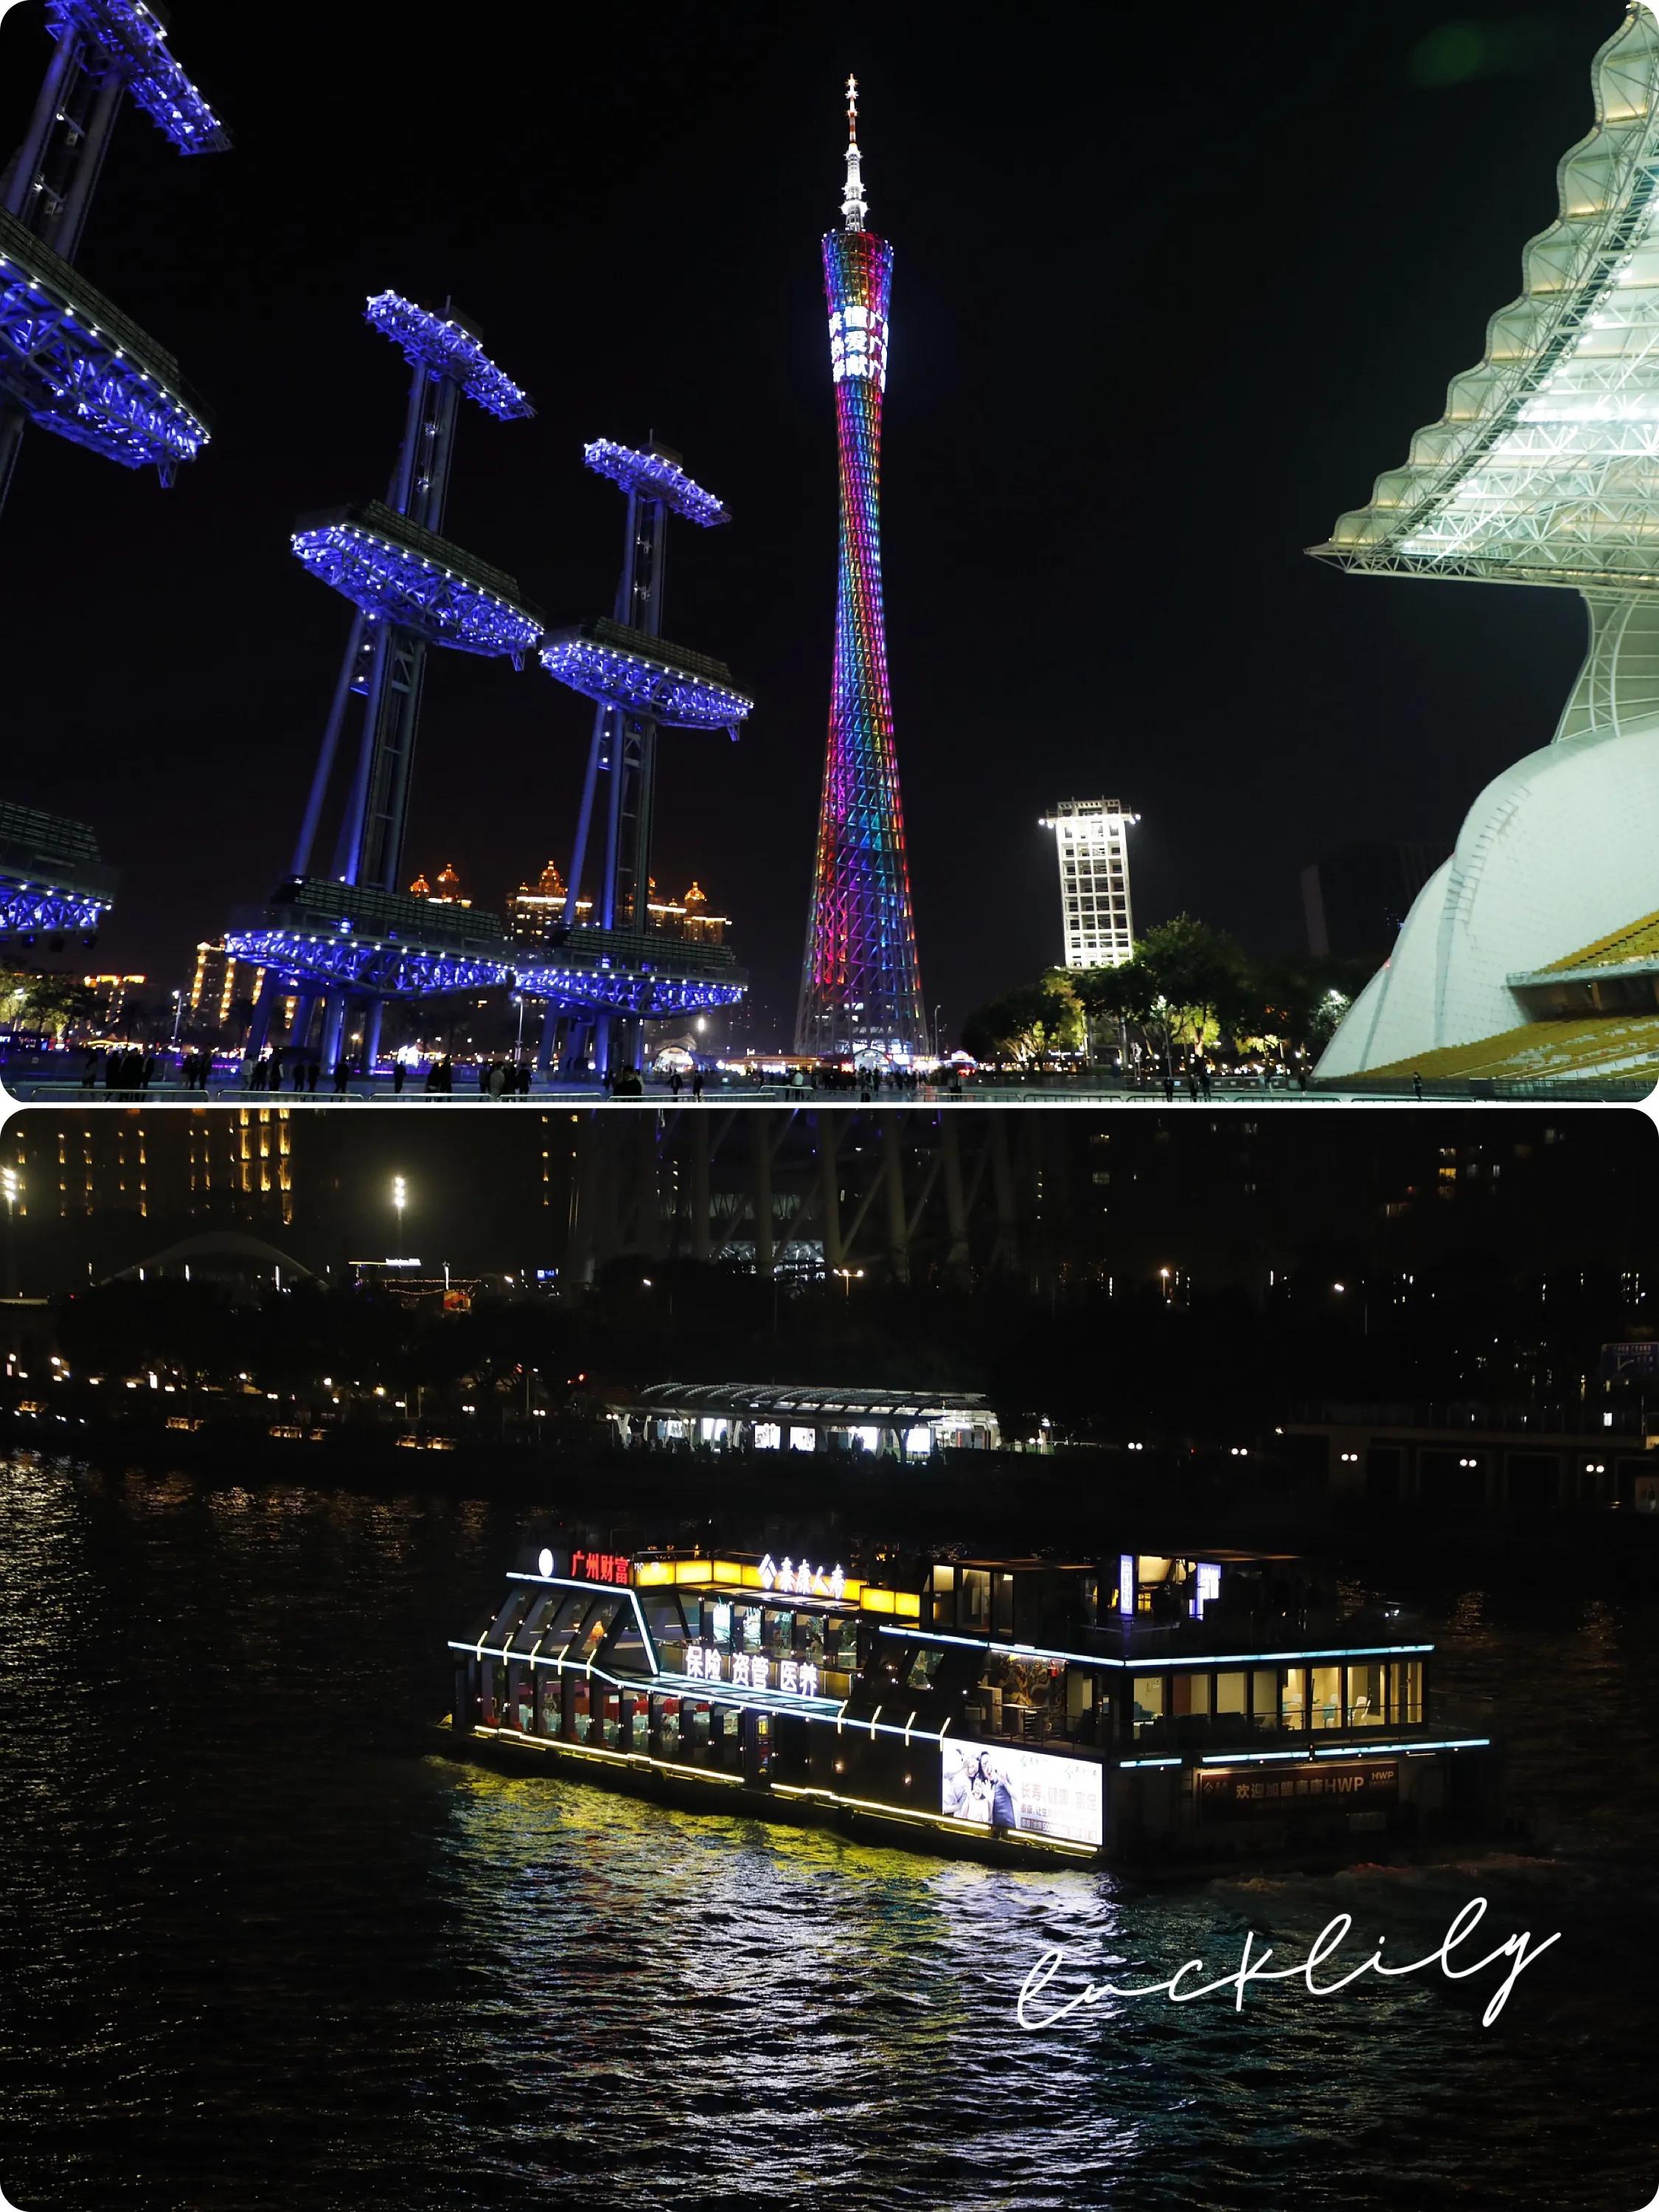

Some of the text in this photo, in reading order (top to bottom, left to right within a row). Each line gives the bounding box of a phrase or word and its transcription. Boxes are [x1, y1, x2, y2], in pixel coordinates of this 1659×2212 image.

[571, 1550, 630, 1585] 广州财富
[686, 1645, 818, 1697] 保险 资管 医养
[1371, 1771, 1394, 1780] HWP
